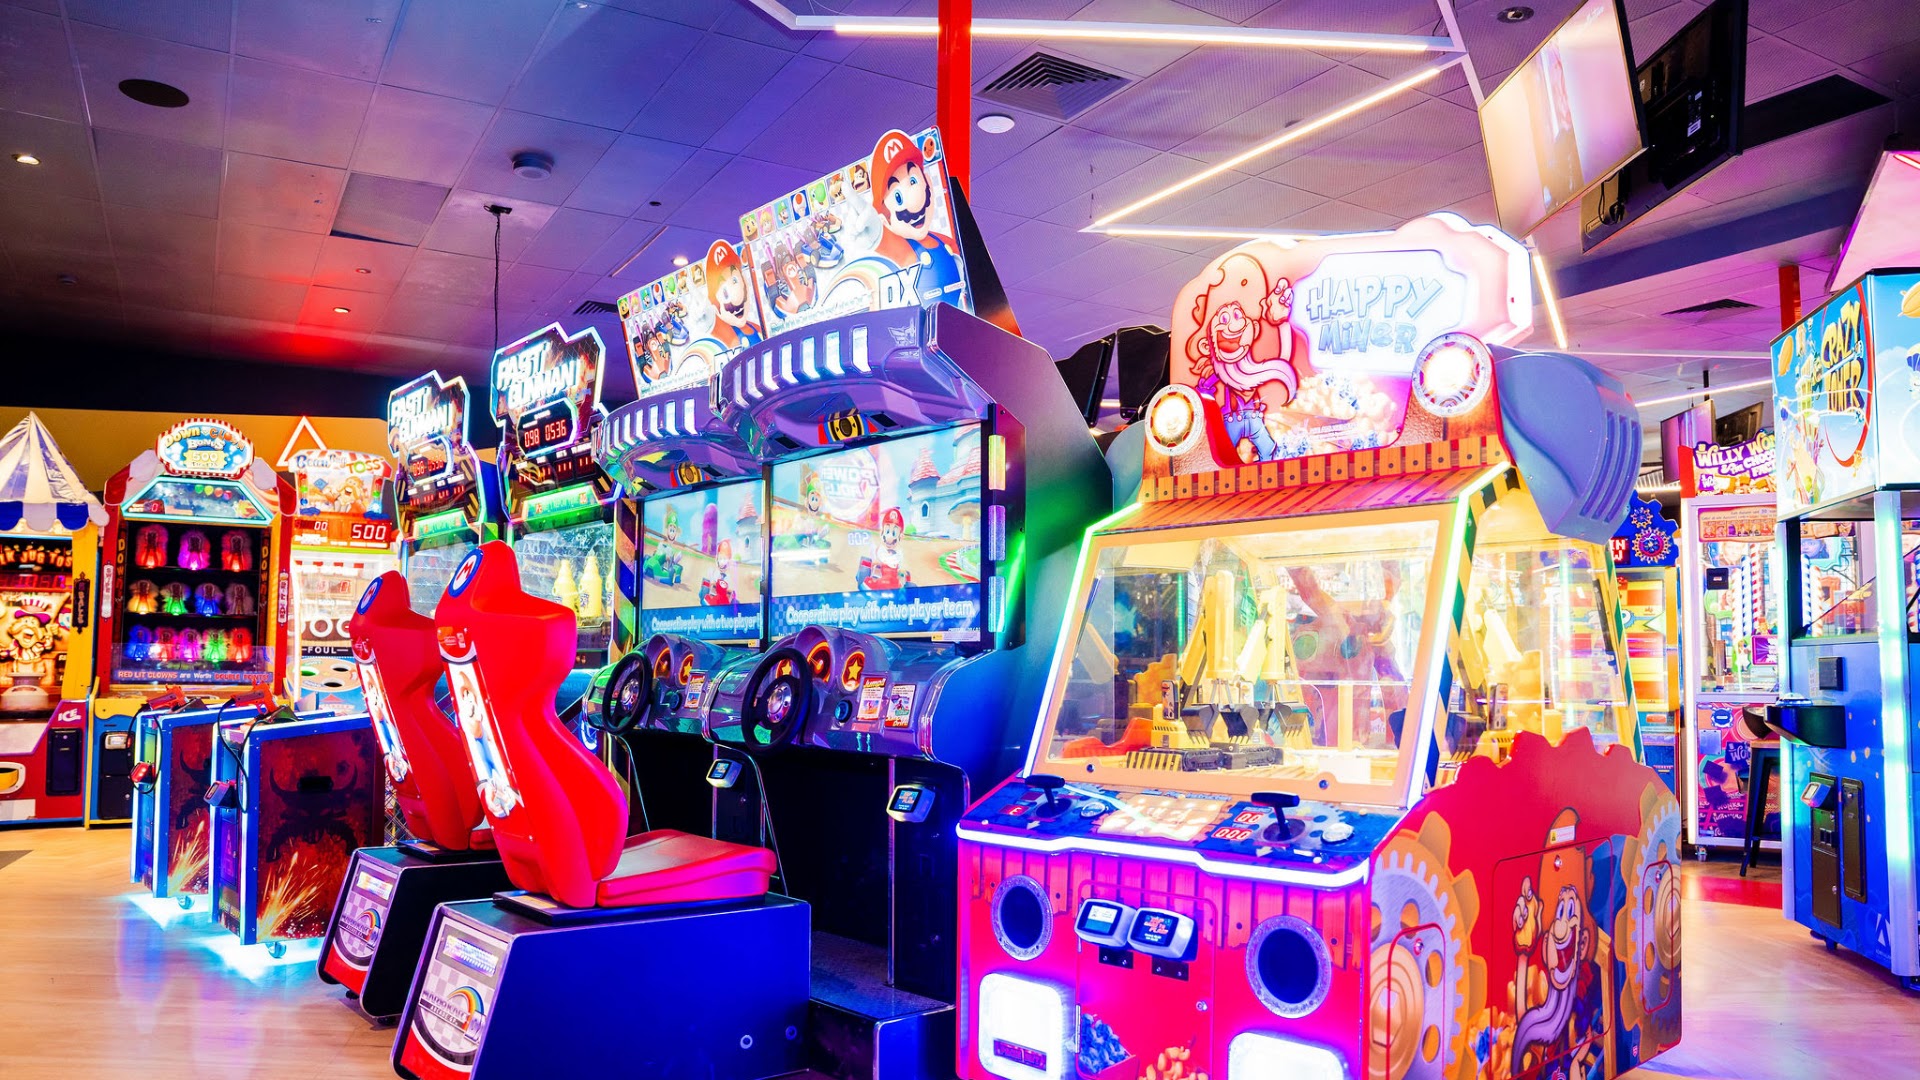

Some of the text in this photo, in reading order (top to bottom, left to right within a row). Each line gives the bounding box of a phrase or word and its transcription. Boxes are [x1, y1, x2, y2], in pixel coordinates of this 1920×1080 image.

[879, 263, 922, 308] DX
[1306, 273, 1443, 322] HAPPY
[1318, 317, 1418, 355] MINER
[1821, 300, 1861, 369] CRAZY
[496, 341, 552, 392] FAST
[507, 358, 581, 410] GUNMAN
[1825, 360, 1864, 413] TOWER
[523, 428, 540, 448] 098
[544, 418, 567, 442] 0536
[192, 452, 218, 461] 500
[346, 459, 381, 474] TOSS
[1696, 444, 1744, 467] WILLY
[352, 524, 386, 540] 500
[20, 549, 45, 564] JUG
[786, 604, 838, 626] Cooperative
[838, 603, 858, 627] play
[860, 601, 881, 623] with
[881, 606, 889, 622] a
[888, 601, 907, 622] two
[906, 598, 943, 626] player
[307, 646, 337, 655] FOUL
[118, 671, 133, 679] RED
[134, 671, 147, 679] LIT
[147, 671, 178, 679] CLOWNS
[58, 708, 82, 722] ICE
